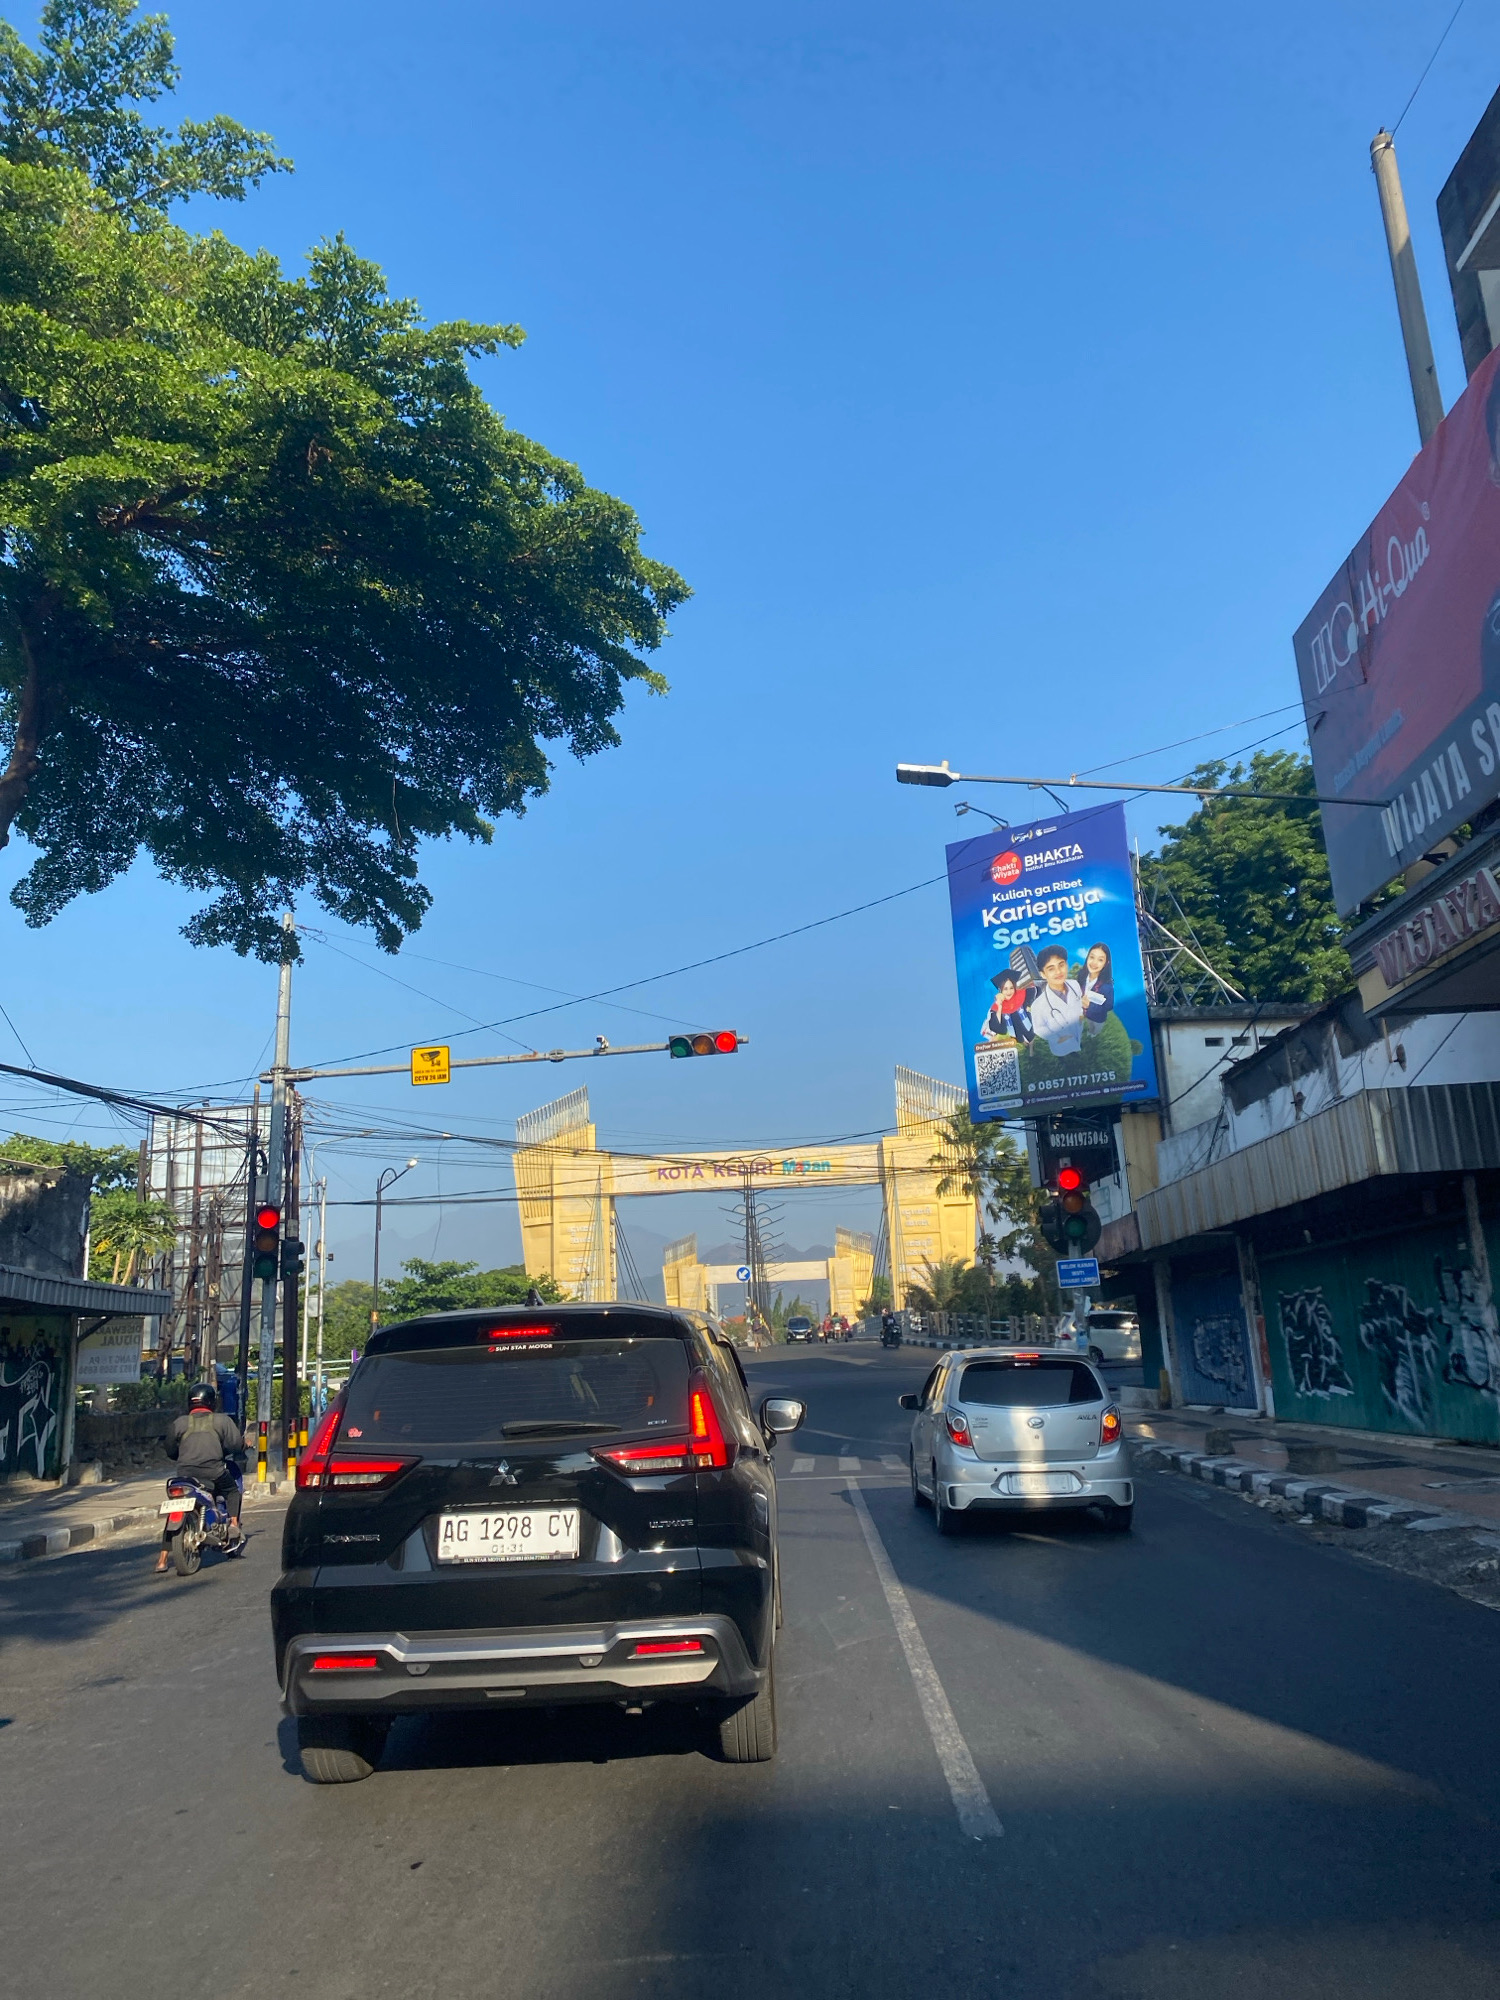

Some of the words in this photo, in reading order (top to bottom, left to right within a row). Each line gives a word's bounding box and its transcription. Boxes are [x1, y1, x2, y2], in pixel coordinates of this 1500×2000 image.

[1381, 741, 1471, 857] WIJAYA
[1024, 844, 1083, 867] BHAKTA
[993, 868, 1020, 880] Wiyata
[992, 887, 1033, 903] Kuliah
[1034, 886, 1051, 897] ga
[1052, 878, 1083, 892] Ribet
[982, 889, 1100, 928] Kariernya
[992, 911, 1089, 950] Sat-Set!
[1372, 867, 1500, 990] WIJAYA
[1038, 1080, 1065, 1091] 0857
[1067, 1075, 1088, 1087] 1717
[1091, 1070, 1116, 1083] 1735
[1050, 1131, 1109, 1148] 082141975045
[657, 1164, 704, 1180] KOTA
[713, 1162, 774, 1178] KEDIRI
[443, 1519, 469, 1542] AG
[480, 1515, 532, 1541] 1298
[548, 1514, 574, 1537] CY
